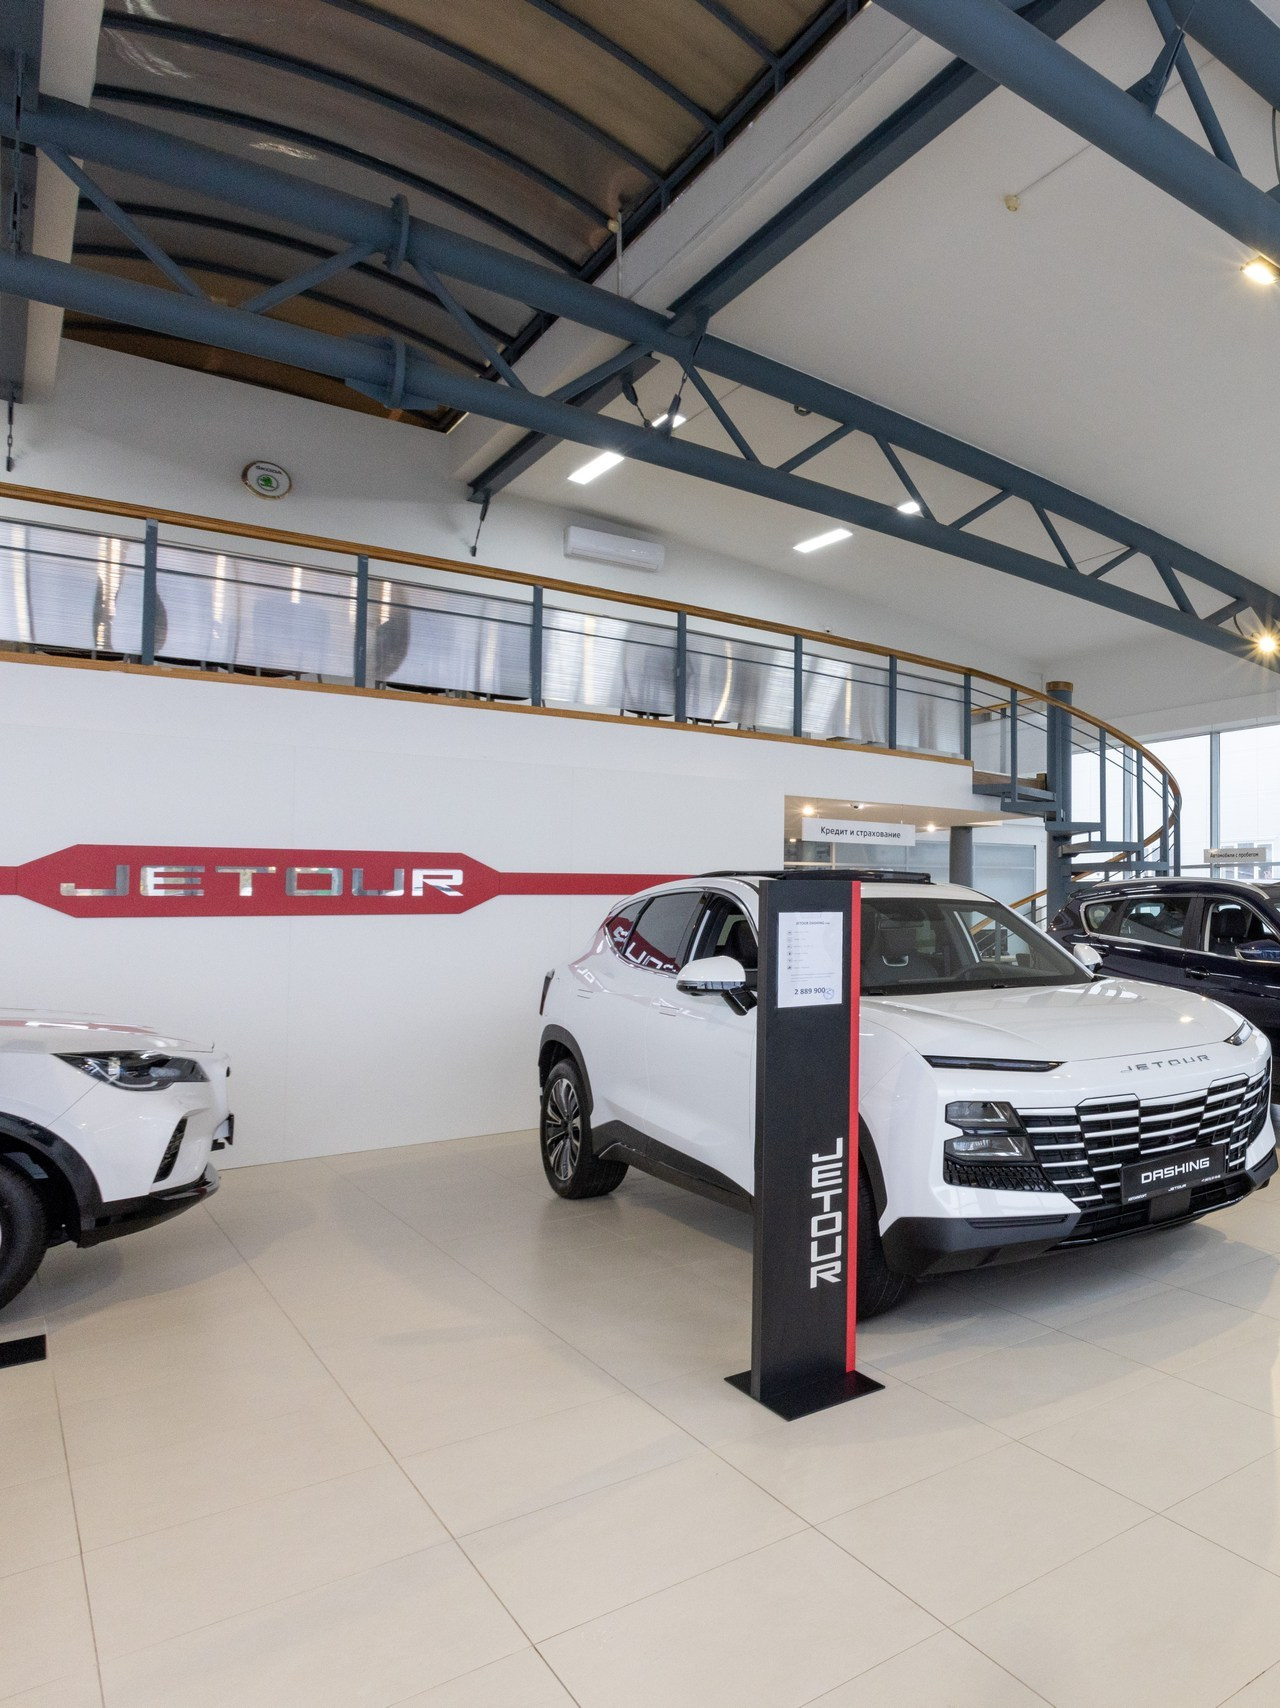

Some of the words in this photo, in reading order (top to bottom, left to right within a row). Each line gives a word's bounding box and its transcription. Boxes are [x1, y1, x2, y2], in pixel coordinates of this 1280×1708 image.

[820, 826, 848, 836] Кредит
[856, 831, 901, 839] страхование
[60, 864, 464, 897] JETOUR
[1120, 1054, 1211, 1073] JETOUR
[1141, 1157, 1210, 1184] DASHING
[809, 1137, 843, 1289] JETOUR
